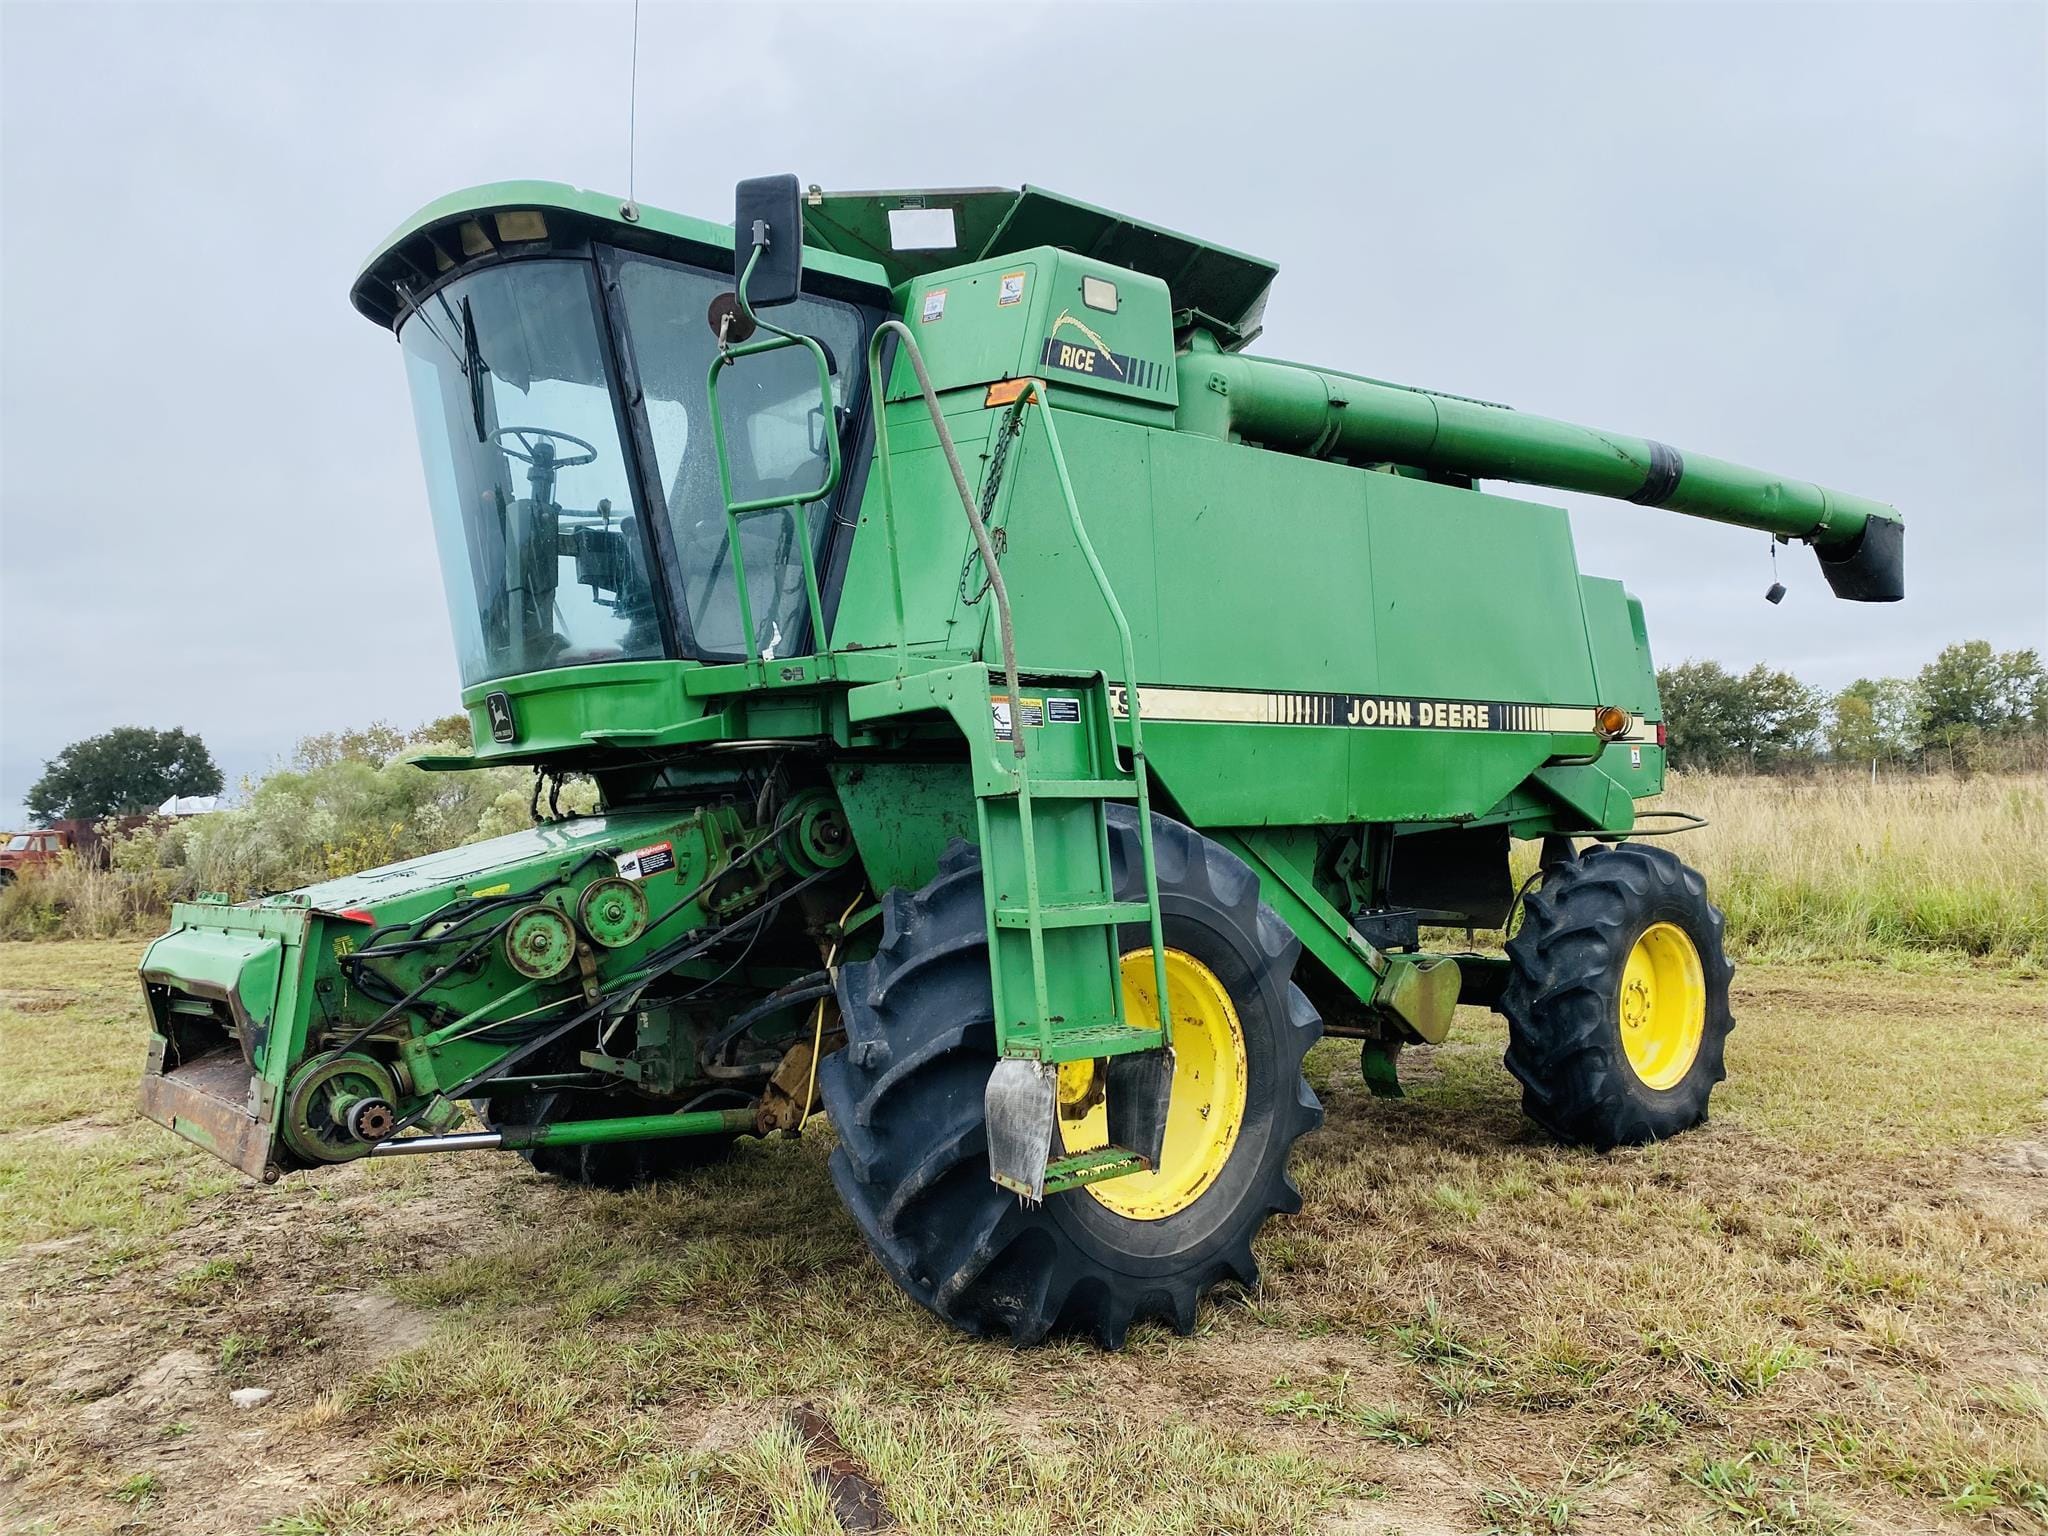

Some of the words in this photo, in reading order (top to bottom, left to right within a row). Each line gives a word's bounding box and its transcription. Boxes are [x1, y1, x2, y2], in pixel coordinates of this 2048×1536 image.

[1060, 345, 1095, 371] RICE
[1347, 699, 1411, 726] JOHN
[1419, 702, 1489, 728] DEERE
